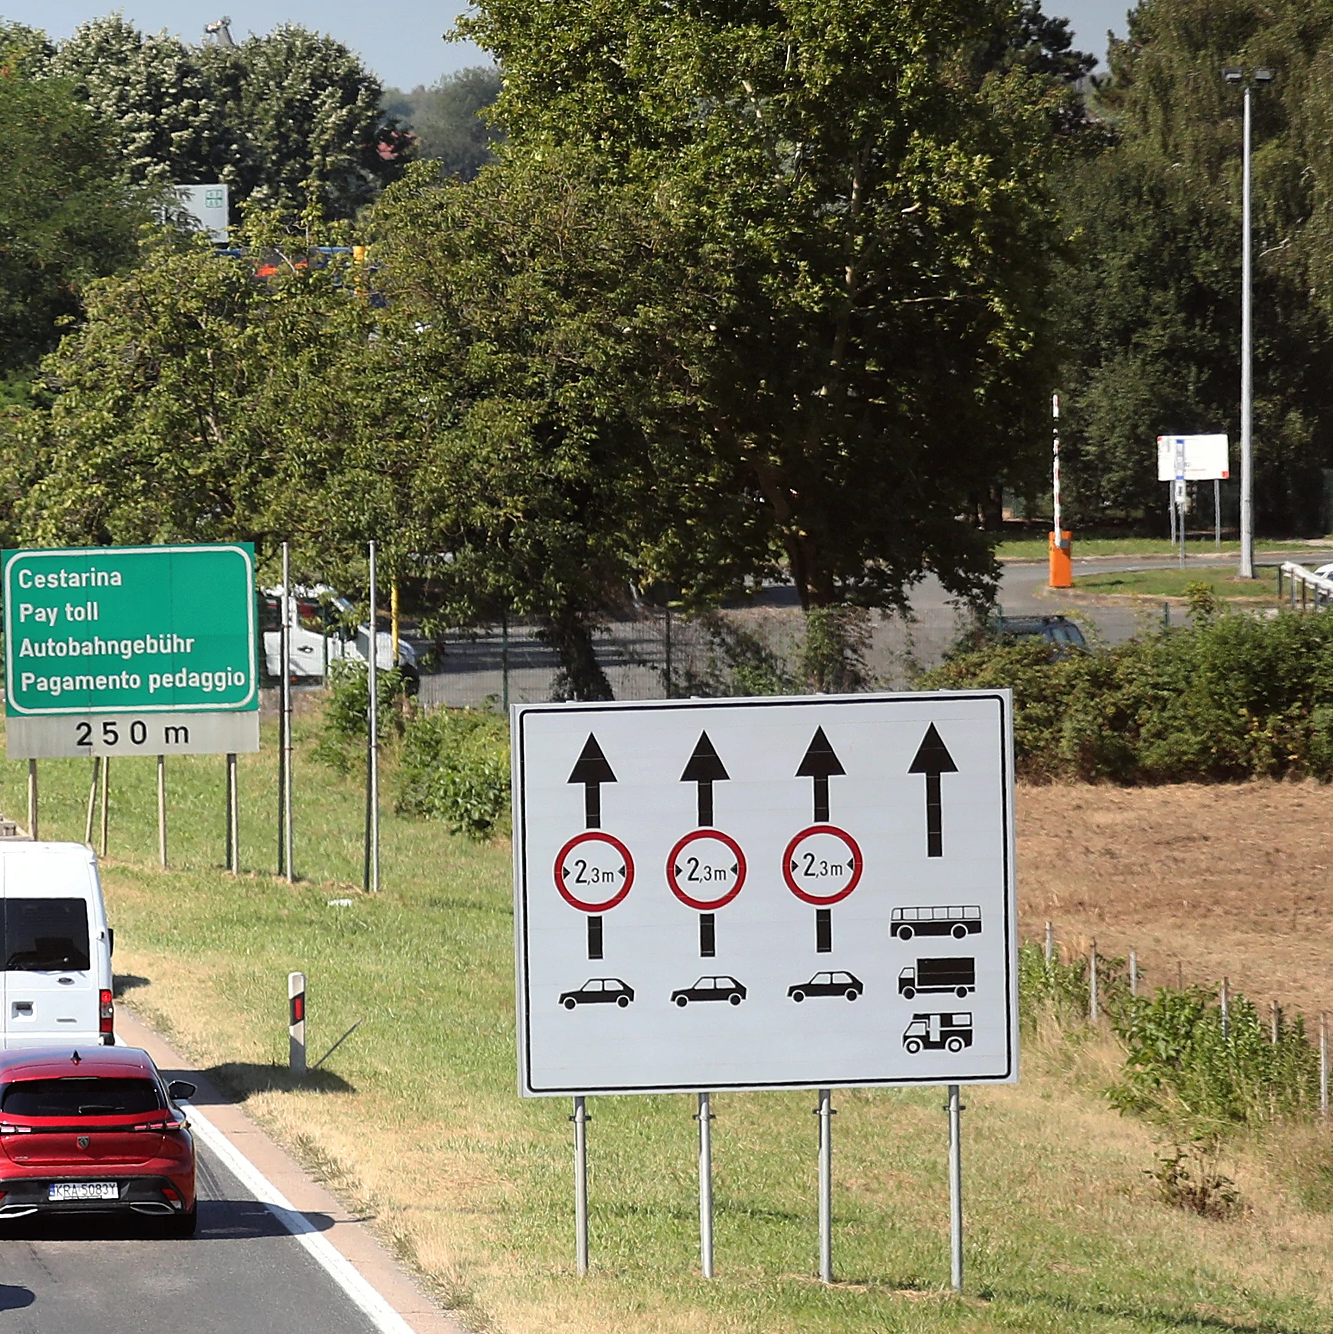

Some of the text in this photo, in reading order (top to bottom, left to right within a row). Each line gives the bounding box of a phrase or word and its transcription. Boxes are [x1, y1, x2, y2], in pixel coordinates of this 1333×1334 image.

[18, 567, 123, 589] Cestarina
[19, 601, 99, 627] Pay toll
[19, 633, 196, 660] Autobahngebühr
[21, 666, 246, 697] Pagamento pedaggio
[75, 720, 190, 747] 250 m
[55, 1183, 116, 1197] KRA 5083Y
